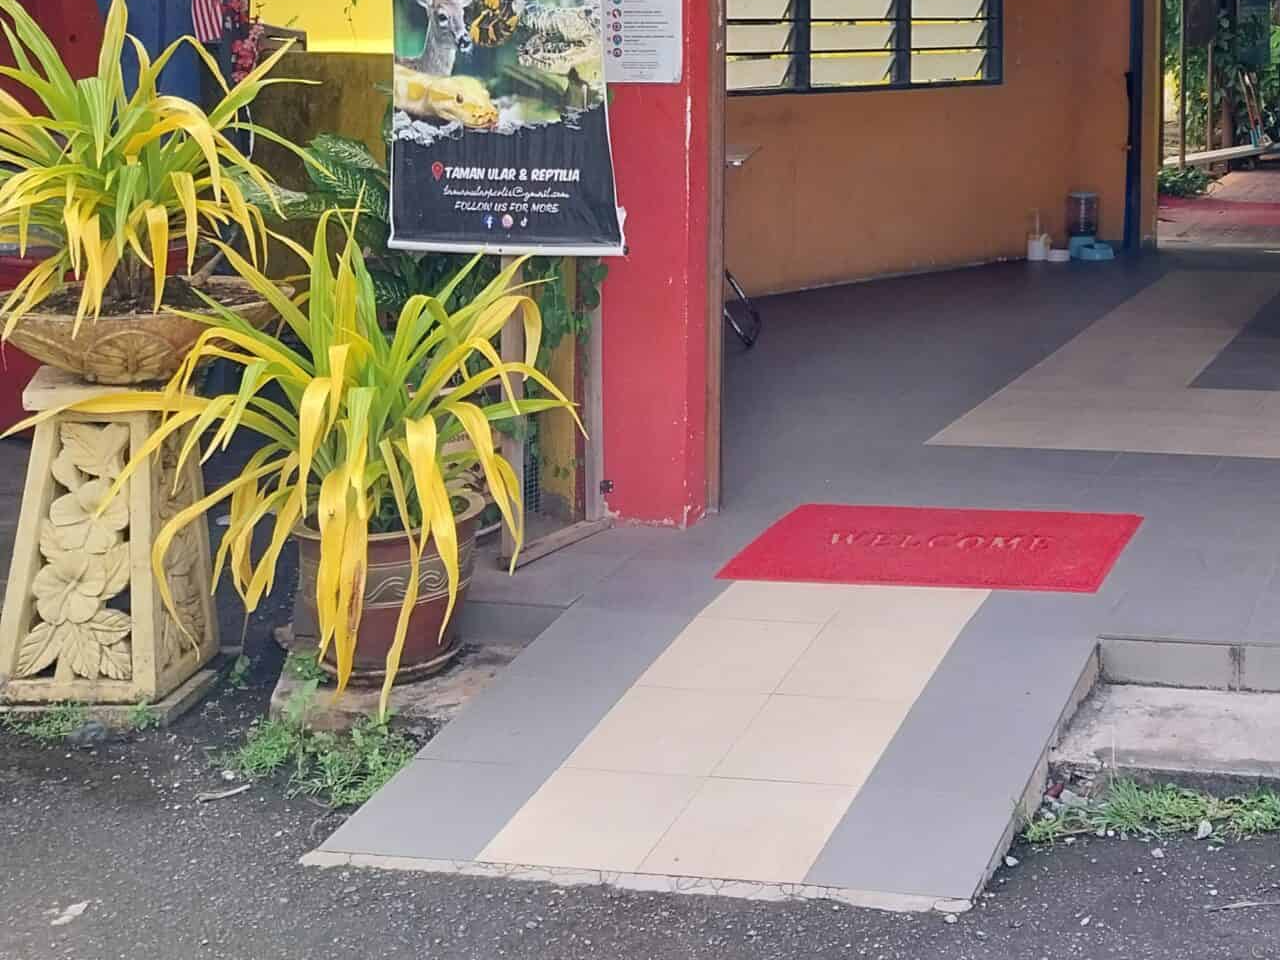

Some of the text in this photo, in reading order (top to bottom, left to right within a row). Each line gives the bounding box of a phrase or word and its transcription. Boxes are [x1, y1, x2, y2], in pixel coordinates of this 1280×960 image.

[444, 166, 580, 182] TAMAN ULAR & REPTILIA
[454, 201, 560, 213] FOLLOW US FOR MORE
[830, 529, 1049, 552] WELCOME
